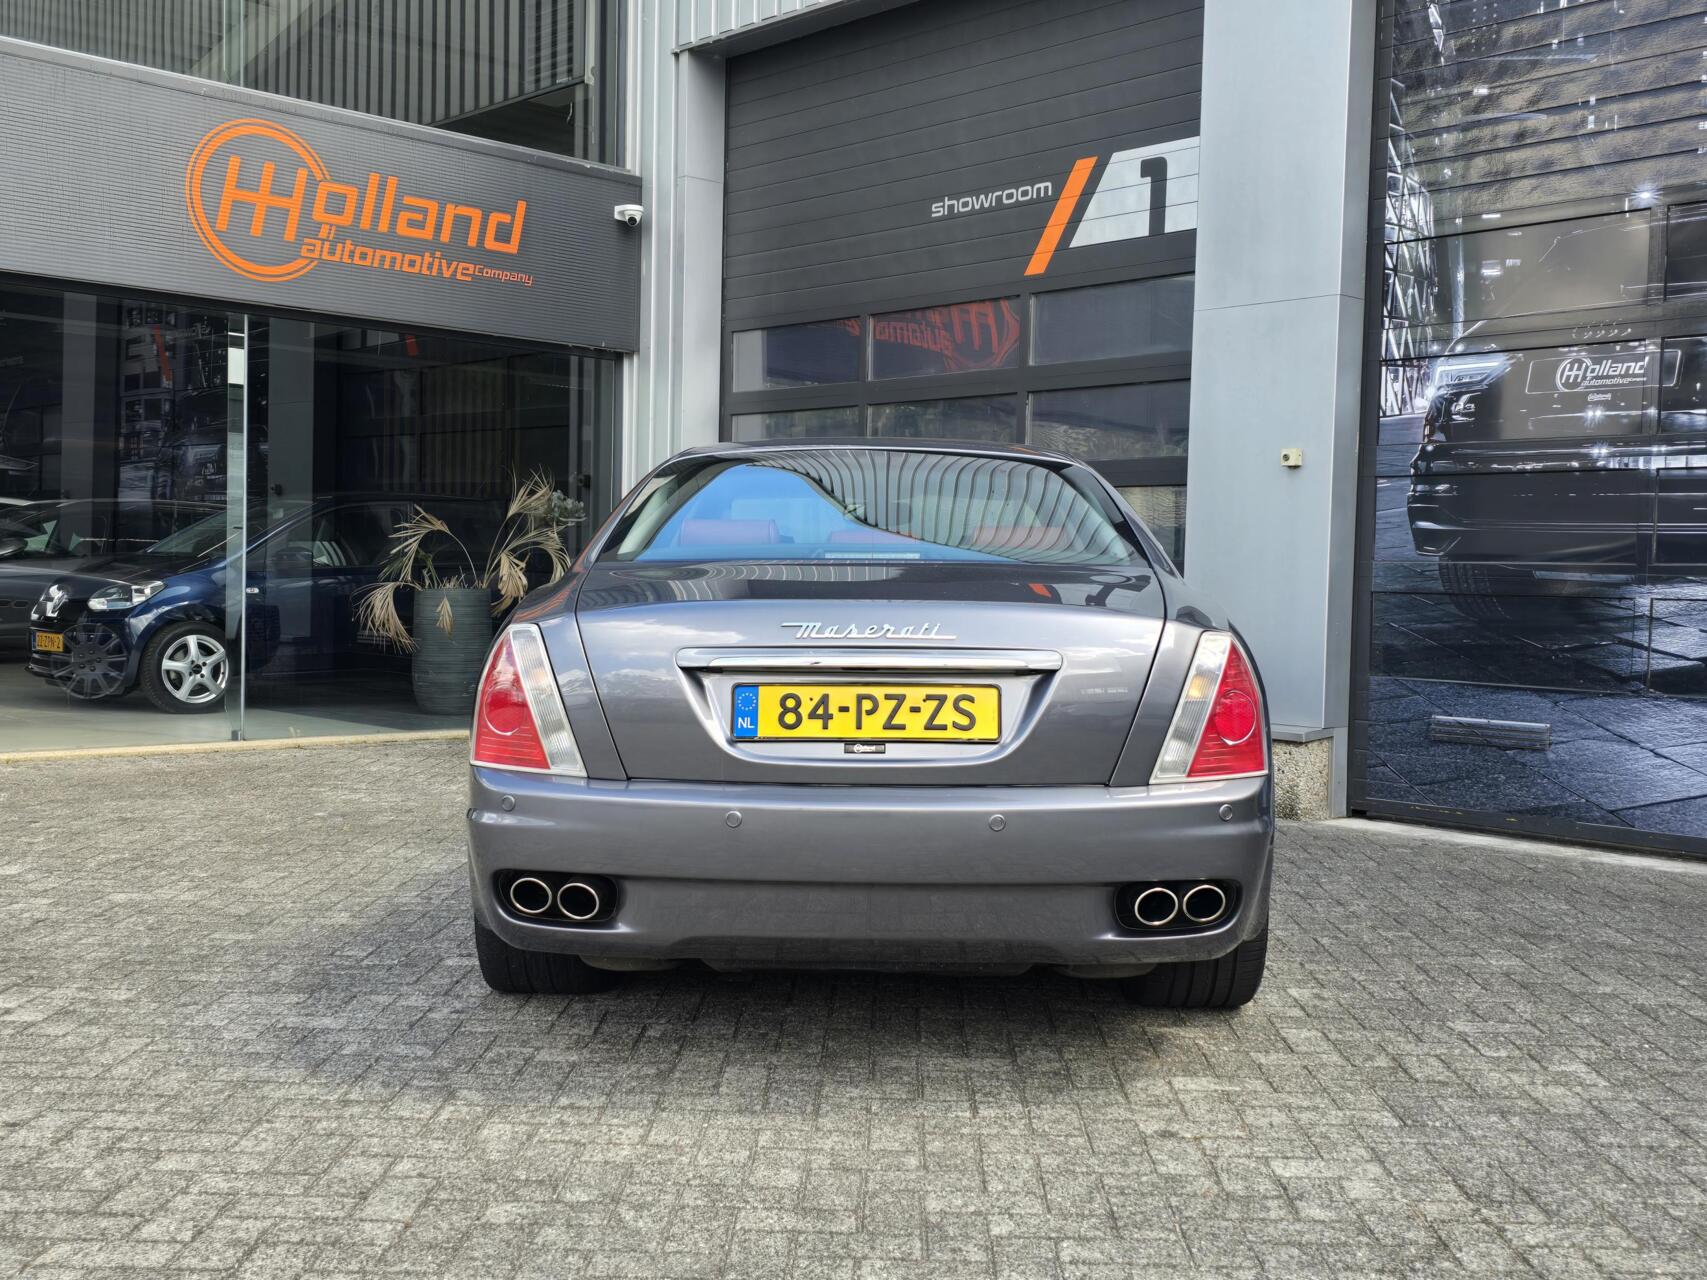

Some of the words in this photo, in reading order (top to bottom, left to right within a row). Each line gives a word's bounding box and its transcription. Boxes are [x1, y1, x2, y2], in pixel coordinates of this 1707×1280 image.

[214, 155, 528, 254] Holland
[930, 180, 1053, 218] showroom
[300, 237, 475, 282] automotive
[780, 620, 957, 640] Maserati
[737, 716, 755, 730] NL
[776, 692, 978, 732] 84-PZ-ZS
